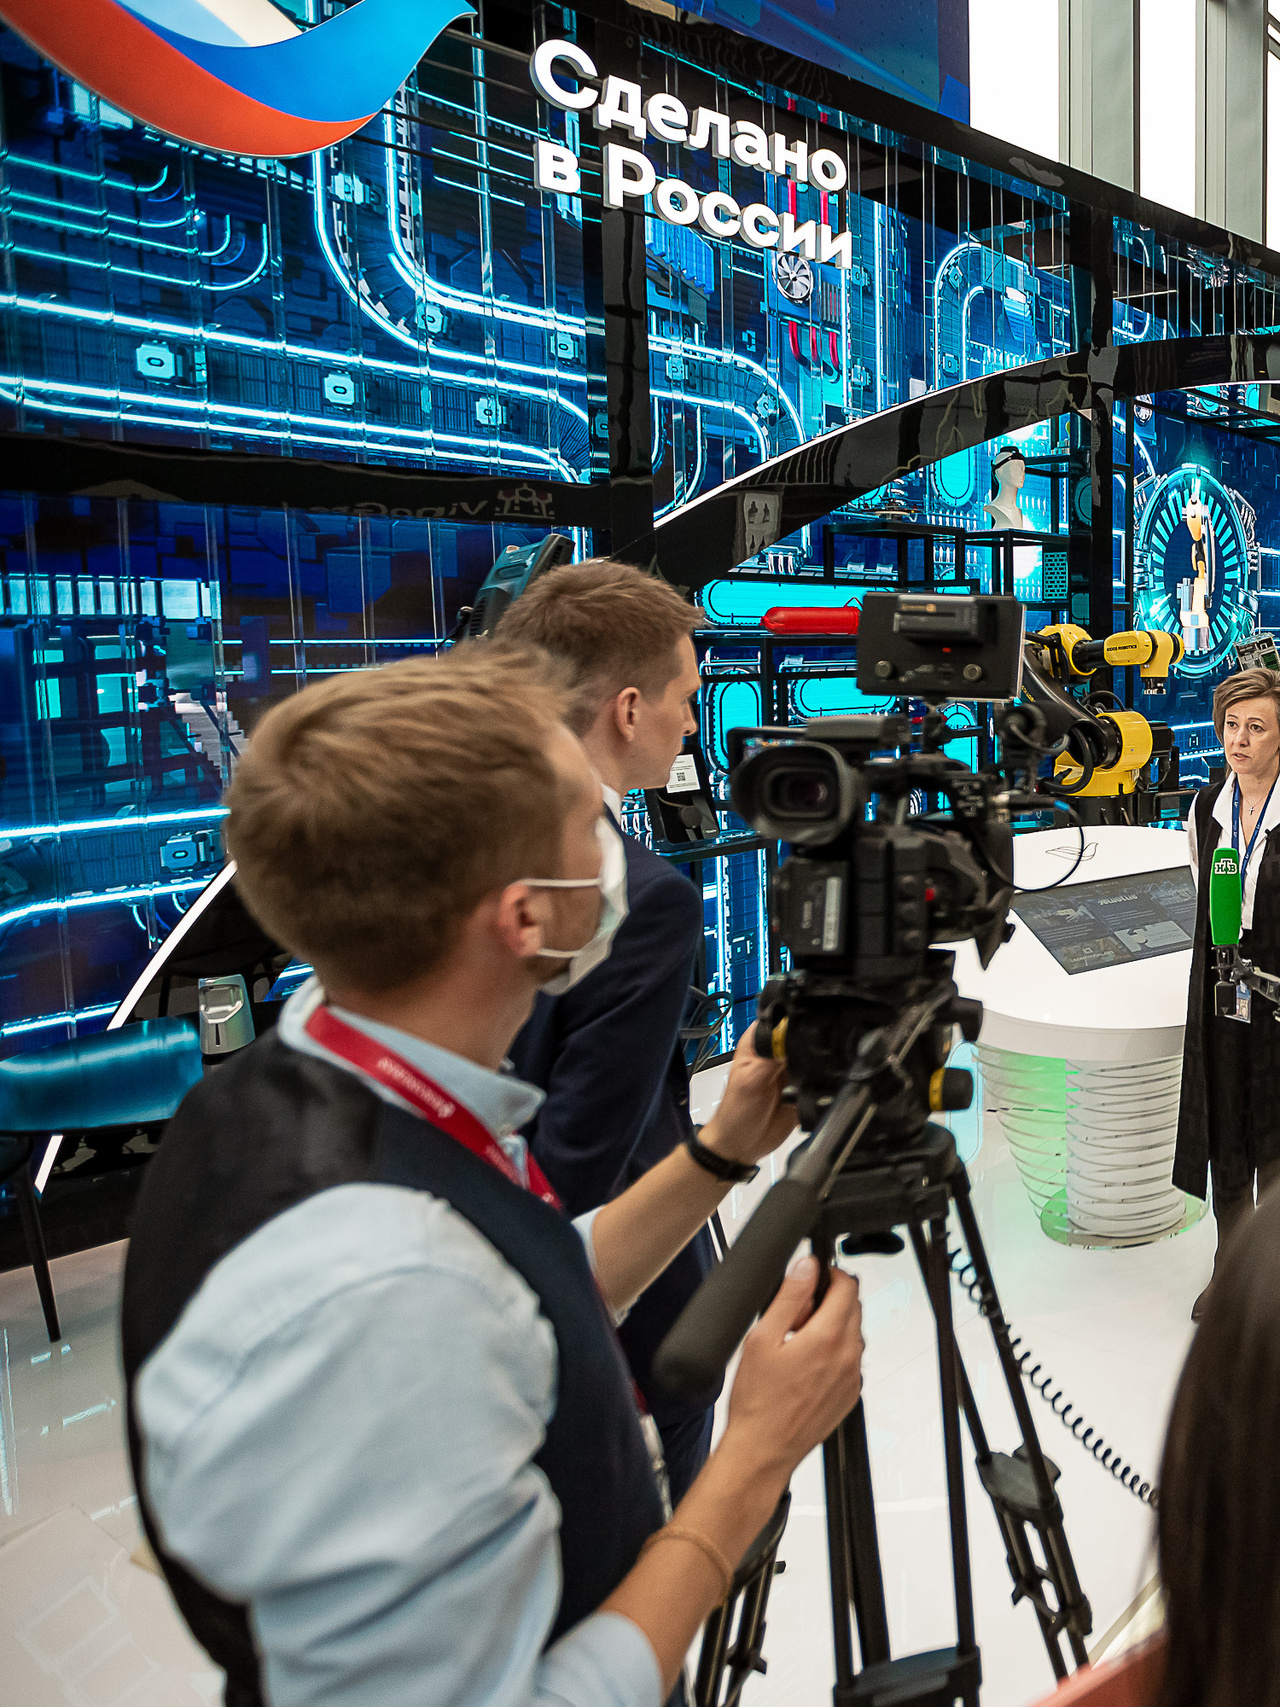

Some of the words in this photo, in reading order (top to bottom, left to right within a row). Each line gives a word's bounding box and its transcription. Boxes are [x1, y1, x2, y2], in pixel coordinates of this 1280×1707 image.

[530, 38, 847, 191] Сделано
[534, 139, 581, 193] в
[603, 142, 852, 270] России
[1214, 858, 1238, 875] НТВ
